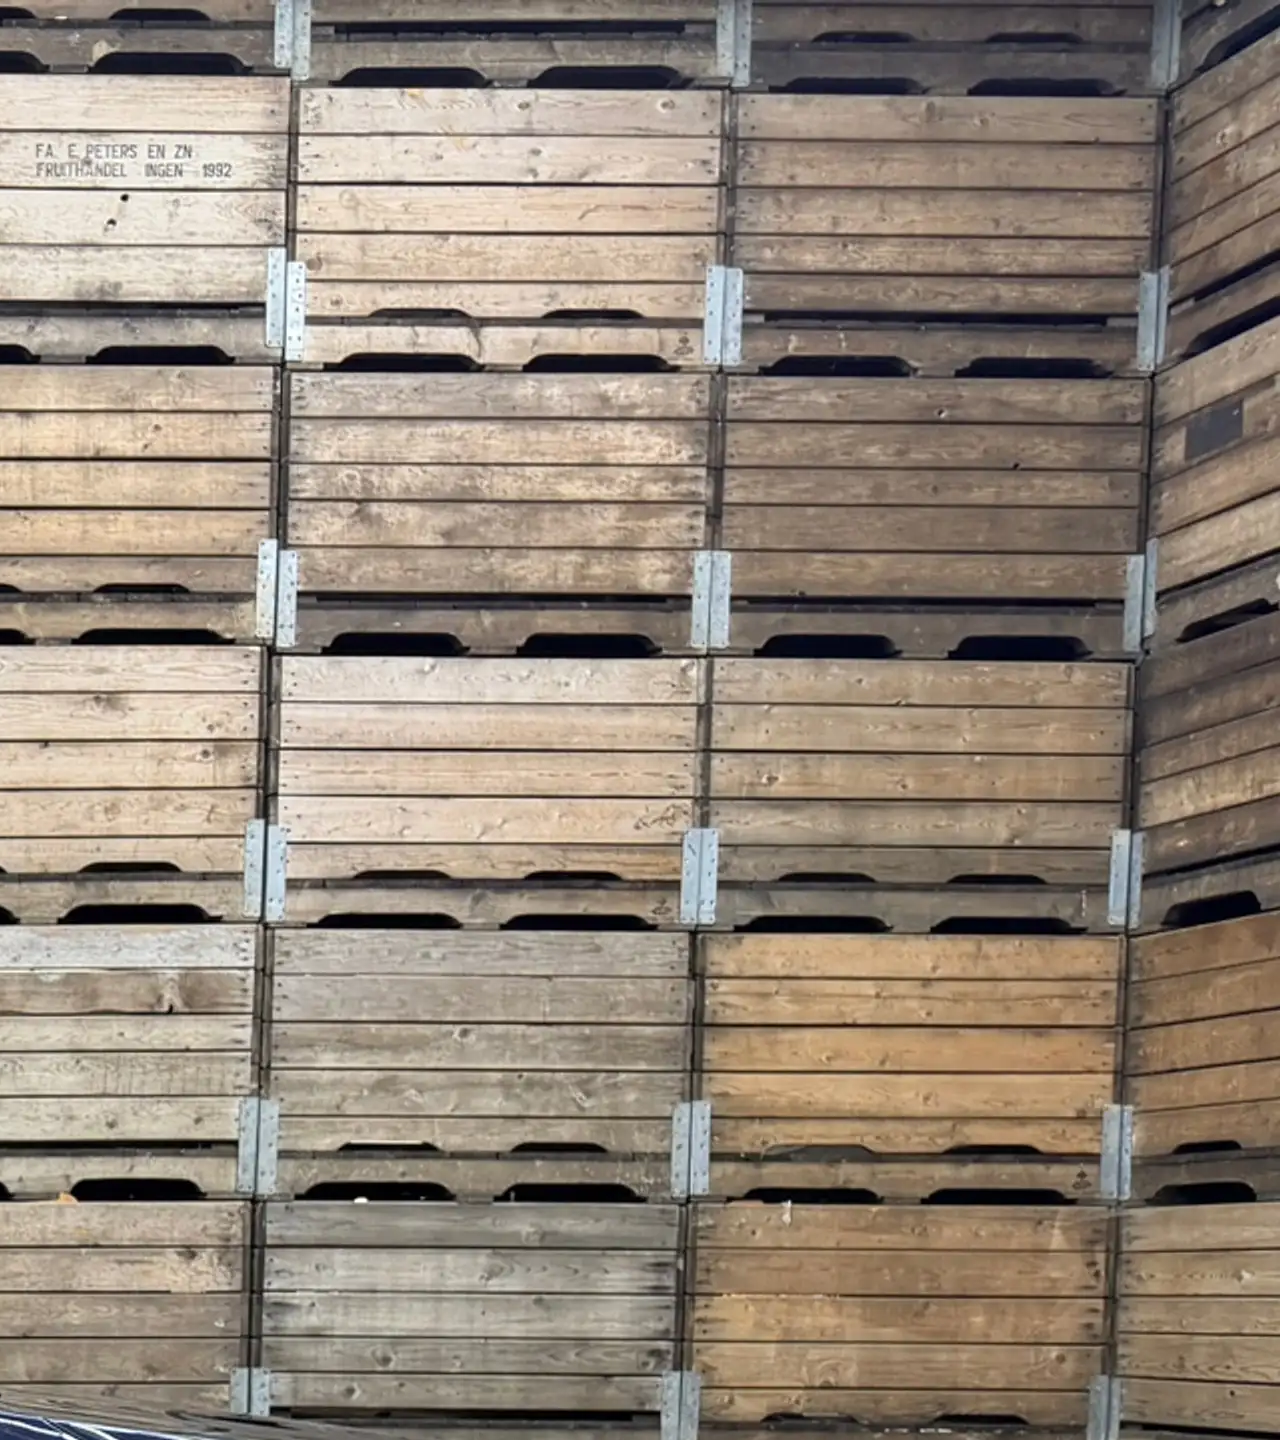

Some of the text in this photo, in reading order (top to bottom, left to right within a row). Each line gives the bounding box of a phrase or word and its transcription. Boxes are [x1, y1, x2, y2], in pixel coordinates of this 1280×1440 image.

[86, 143, 138, 159] PETERS
[147, 143, 166, 159] EN
[174, 143, 193, 159] ZN
[35, 162, 233, 179] FRUITHANDEL INGEN 1992
